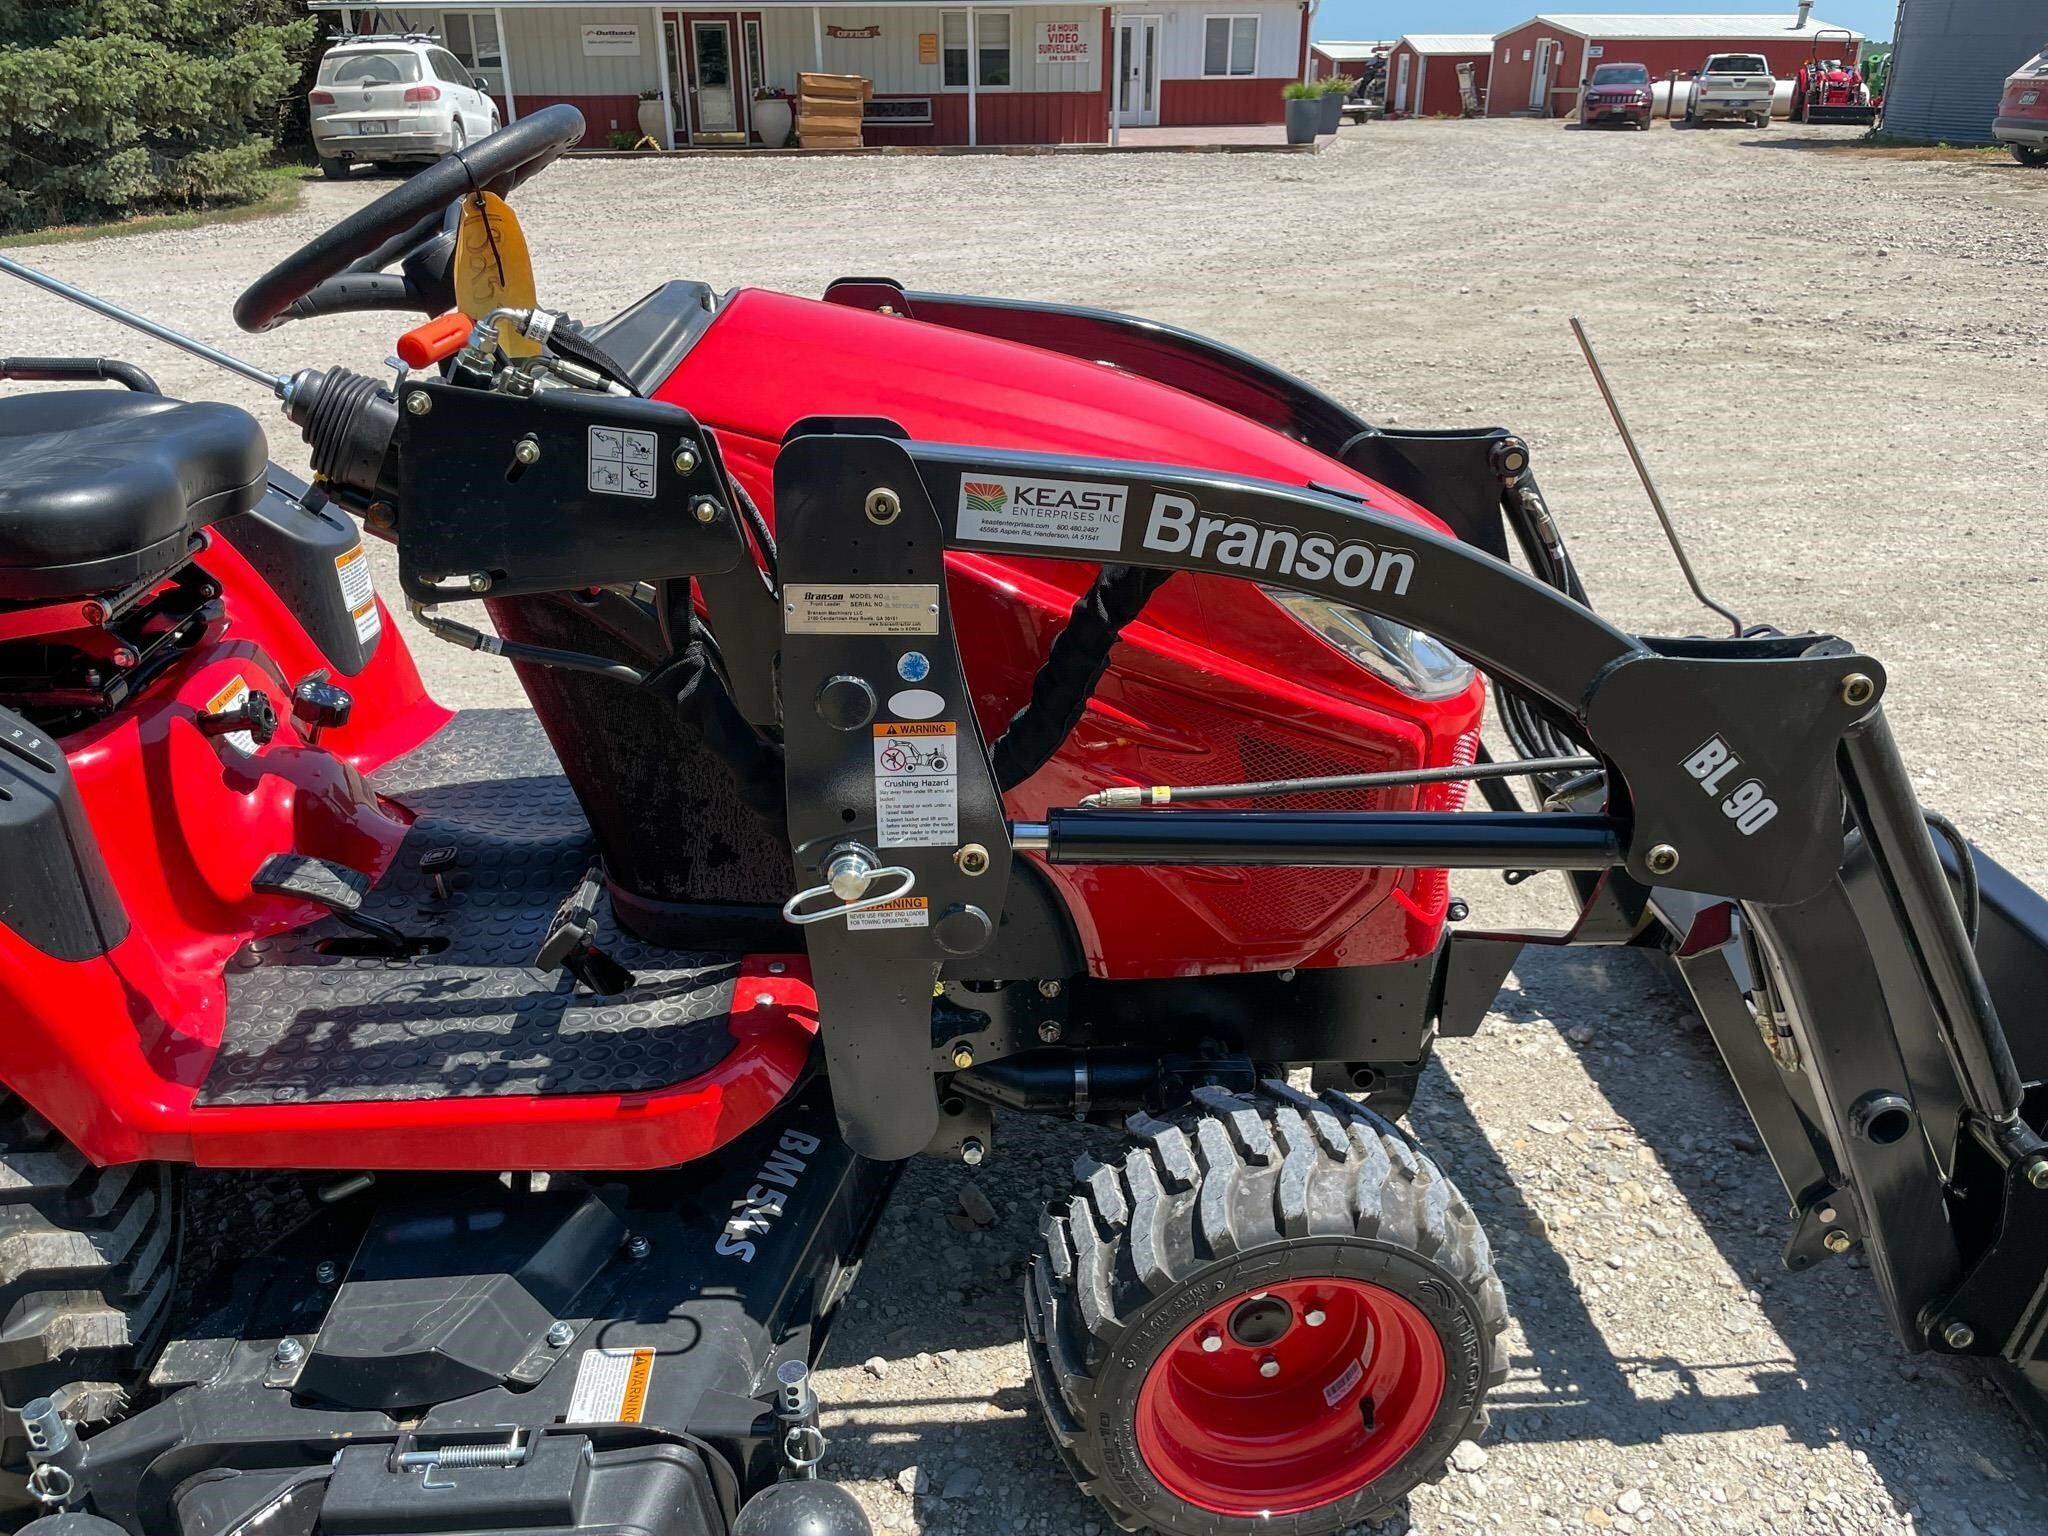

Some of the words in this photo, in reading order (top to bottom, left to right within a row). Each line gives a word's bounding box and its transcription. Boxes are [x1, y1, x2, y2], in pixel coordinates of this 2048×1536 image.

[1047, 24, 1056, 32] 24
[1058, 24, 1078, 32] HOUR
[1048, 33, 1078, 43] VIDEO
[1038, 44, 1088, 54] SURVEILLANCE
[1014, 486, 1122, 512] KEAST
[1012, 506, 1095, 522] ENTERPRISES
[1099, 514, 1120, 524] INC
[981, 518, 1050, 529] keastenterprises.com
[999, 528, 1020, 536] Aspen
[1034, 530, 1070, 540] Henderson,
[1143, 494, 1416, 596] Branson
[804, 592, 844, 600] Branson
[900, 725, 946, 734] WARNING
[1683, 738, 1740, 798] BL
[1721, 782, 1779, 836] 90
[714, 1128, 821, 1264] BM54S
